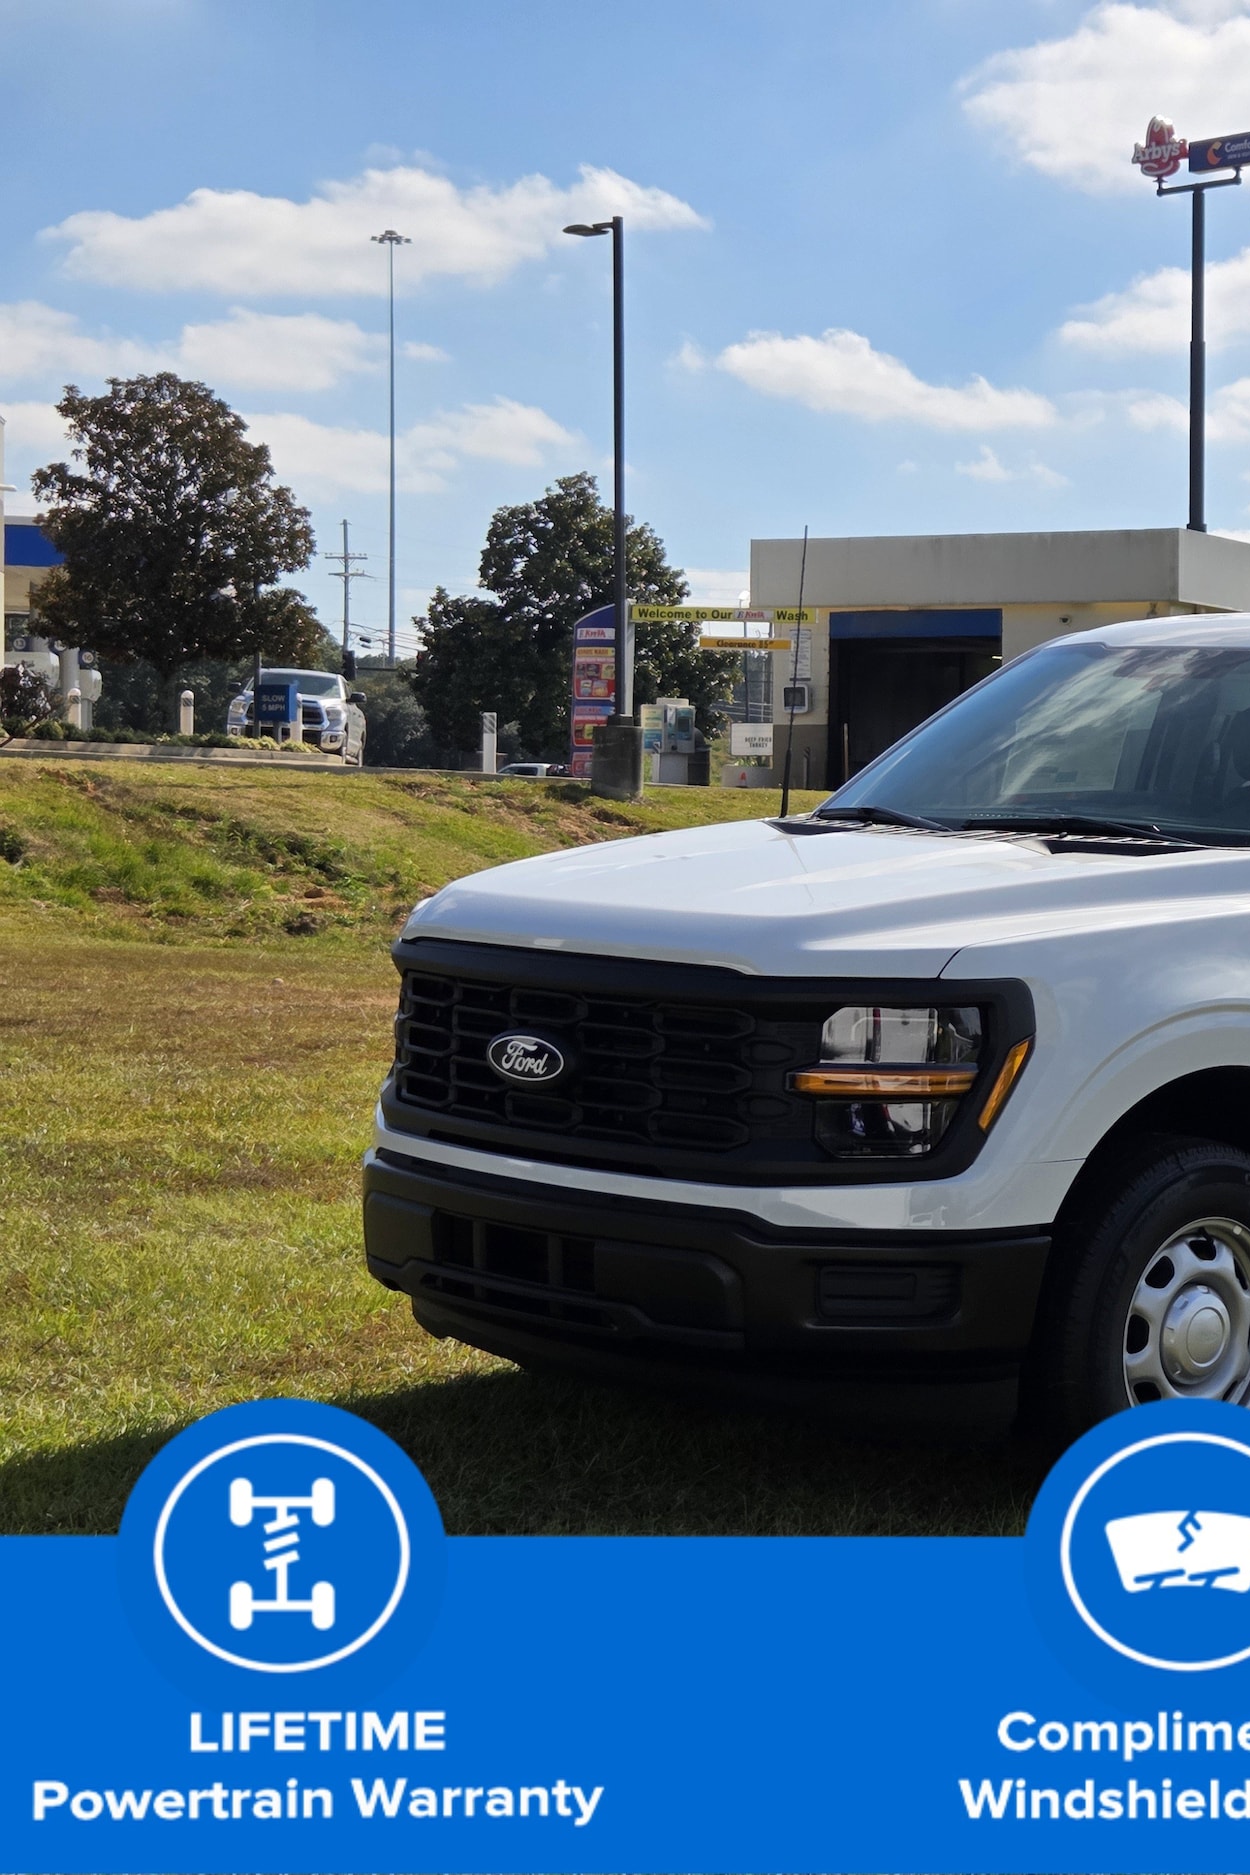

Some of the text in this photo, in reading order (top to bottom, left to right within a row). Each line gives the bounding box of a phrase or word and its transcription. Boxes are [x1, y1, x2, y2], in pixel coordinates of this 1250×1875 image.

[638, 608, 692, 619] Welcome
[695, 610, 707, 619] to
[711, 609, 733, 619] Our
[776, 610, 808, 621] Wash
[716, 640, 757, 649] Clearance
[262, 694, 286, 702] SLOW
[501, 1040, 549, 1075] Ford
